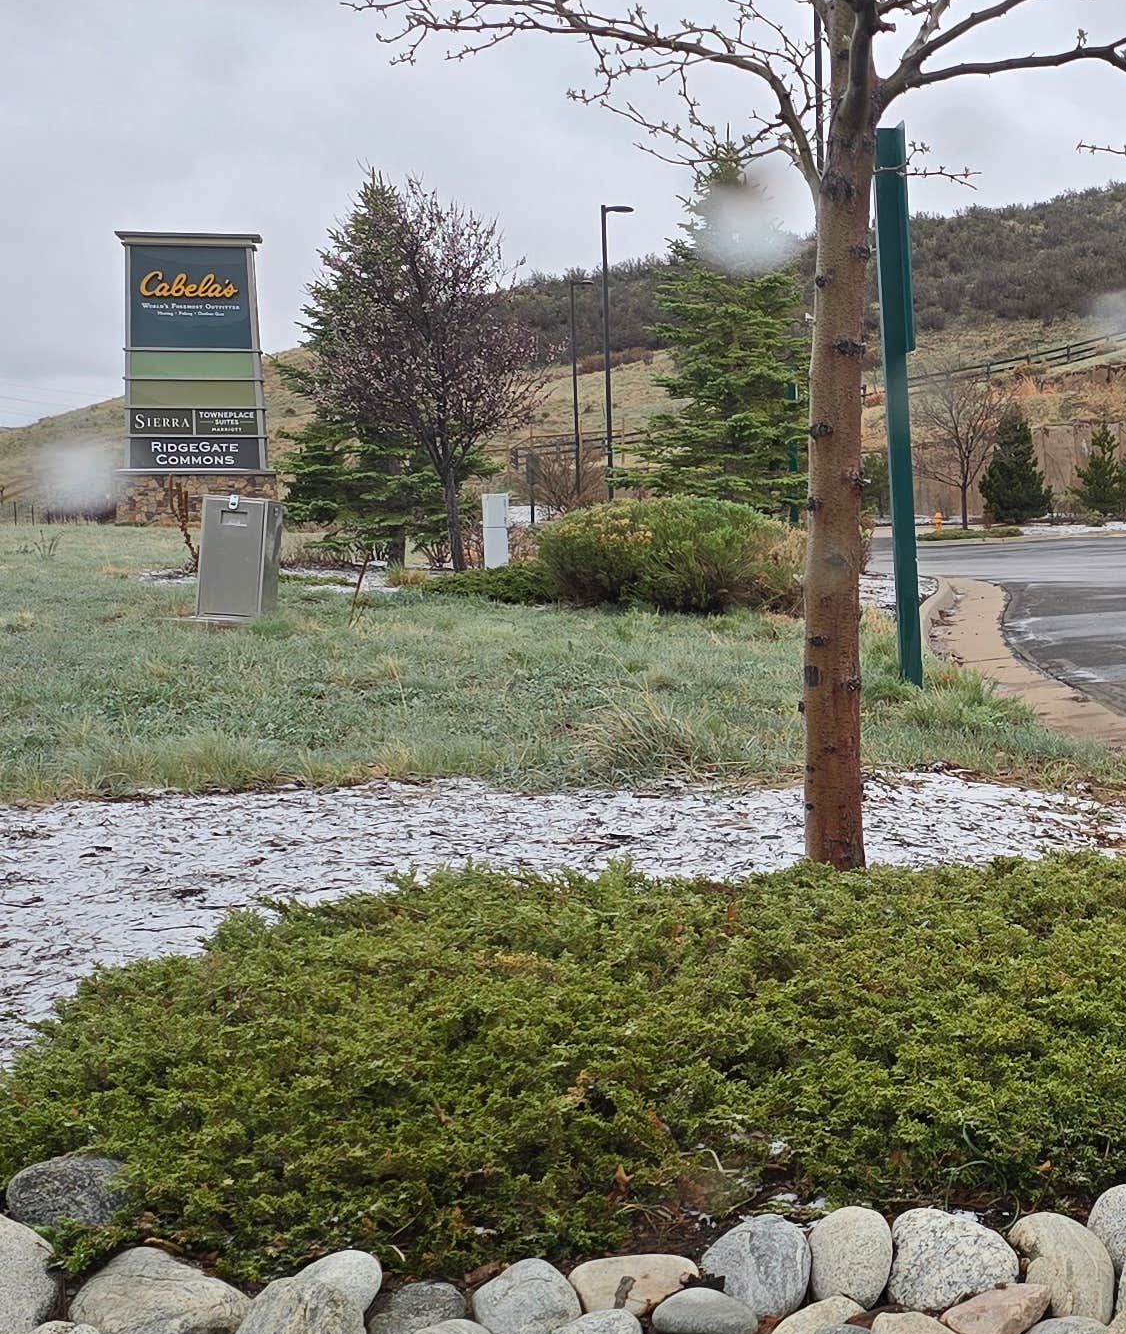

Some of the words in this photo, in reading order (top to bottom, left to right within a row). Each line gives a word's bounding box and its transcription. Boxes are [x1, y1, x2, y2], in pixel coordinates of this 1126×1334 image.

[140, 270, 239, 297] Cabela's
[134, 413, 190, 429] SIERRA
[156, 454, 235, 465] COMMONS
